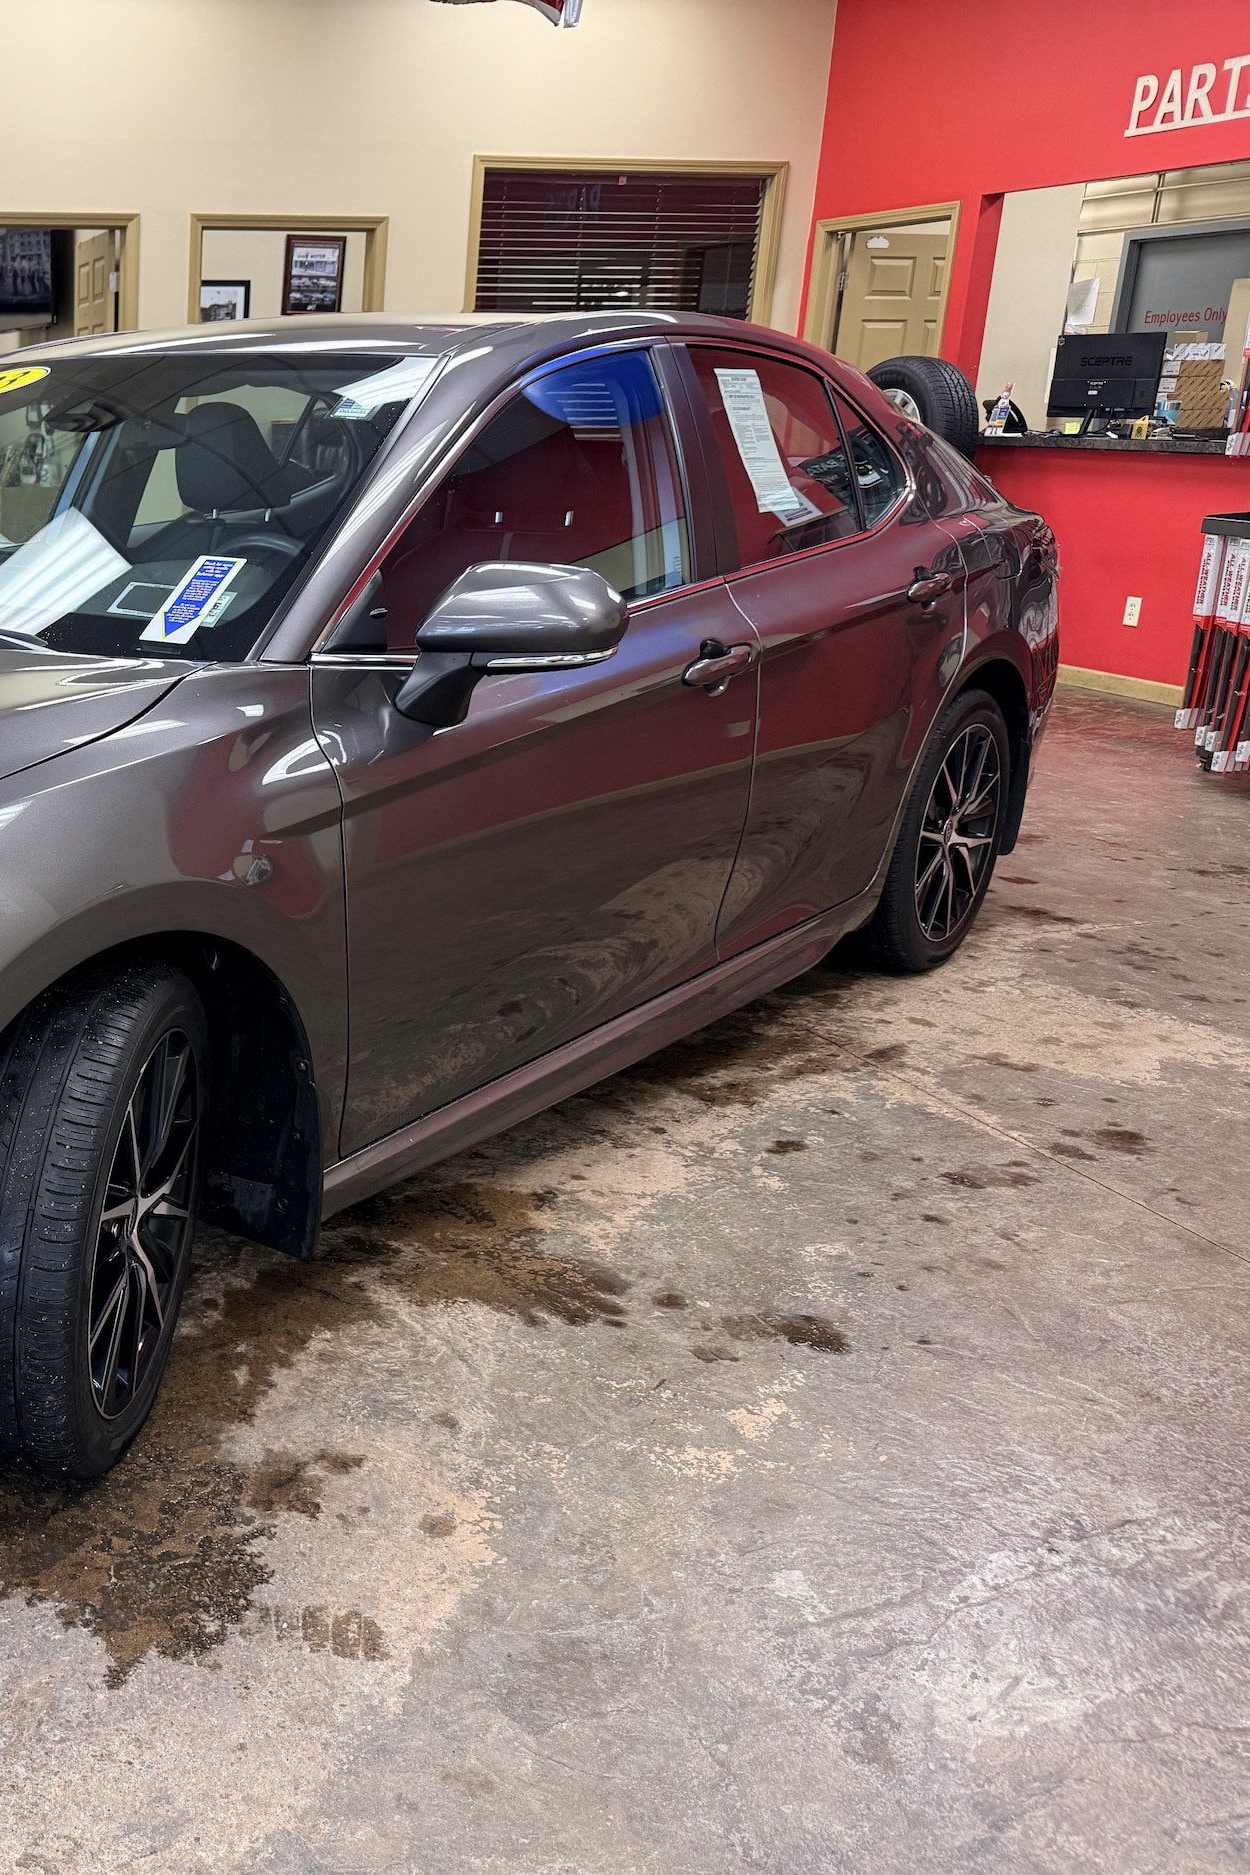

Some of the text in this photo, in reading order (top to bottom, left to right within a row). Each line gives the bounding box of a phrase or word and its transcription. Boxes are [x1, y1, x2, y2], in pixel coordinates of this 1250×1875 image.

[1128, 54, 1250, 129] PART
[1145, 307, 1227, 327] Employees Only
[1080, 356, 1133, 367] SCEPTRE
[1200, 553, 1211, 604] ALL-WEATHER
[1223, 553, 1235, 606] ALL-WEATHER
[1234, 558, 1246, 610] ALL-WEATHER
